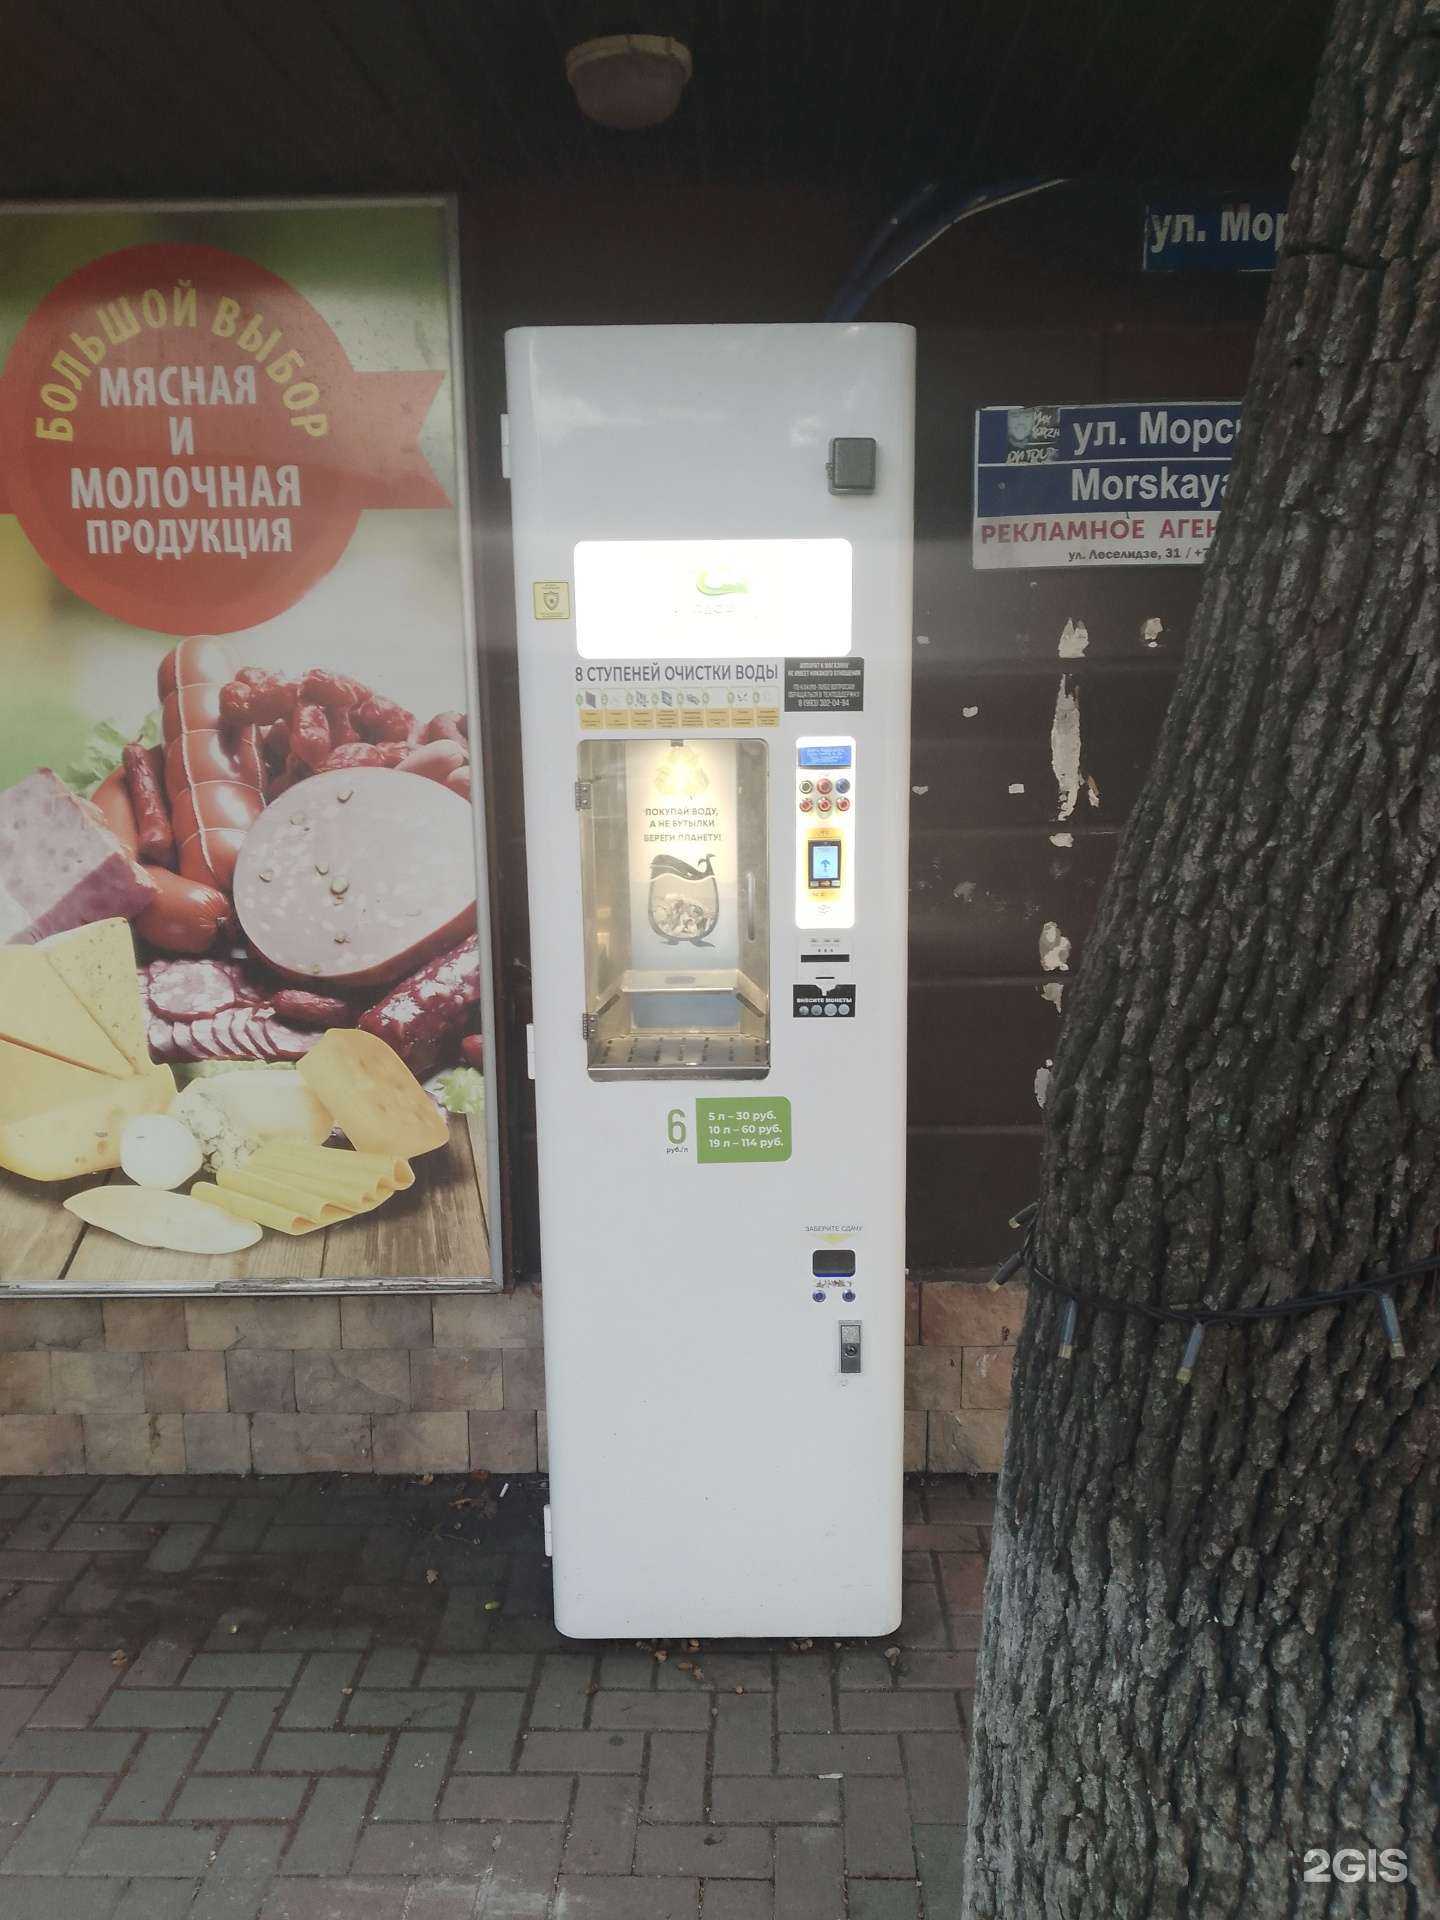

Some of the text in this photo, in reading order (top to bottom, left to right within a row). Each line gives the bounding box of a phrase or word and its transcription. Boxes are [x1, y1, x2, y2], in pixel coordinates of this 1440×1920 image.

[1151, 213, 1206, 253] ул.
[35, 279, 329, 442] БОЛЬШОЙ ВЫБОР
[100, 365, 257, 407] МЯСНАЯ
[169, 416, 195, 455] И
[1072, 410, 1241, 456] ул. Морс
[71, 464, 301, 509] МОЛОЧНАЯ
[86, 517, 293, 559] ПРОДУКЦИЯ
[982, 518, 1145, 544] РЕКЛАМНОЕ
[1069, 551, 1086, 562] ул.
[1165, 547, 1181, 559] 31
[575, 662, 778, 682] 8 СТУПЕНЕЙ ОЧИСТКИ ВОДЫ
[645, 806, 719, 817] ПОКУПАЙ ВОДУ,
[649, 819, 715, 828] А НЕ БУТЫЛКИ
[644, 833, 675, 842] БЕРЕГИ
[667, 1108, 687, 1145] 6
[708, 1112, 716, 1121] 5
[718, 1113, 725, 1121] л
[736, 1111, 750, 1120] 30
[752, 1110, 777, 1122] руб.
[709, 1125, 720, 1135] 10
[722, 1126, 731, 1134] л
[741, 1125, 756, 1134] 60
[758, 1124, 783, 1136] руб.
[709, 1138, 720, 1149] 19
[722, 1139, 730, 1148] л
[741, 1138, 757, 1148] 114
[760, 1137, 784, 1149] руб.
